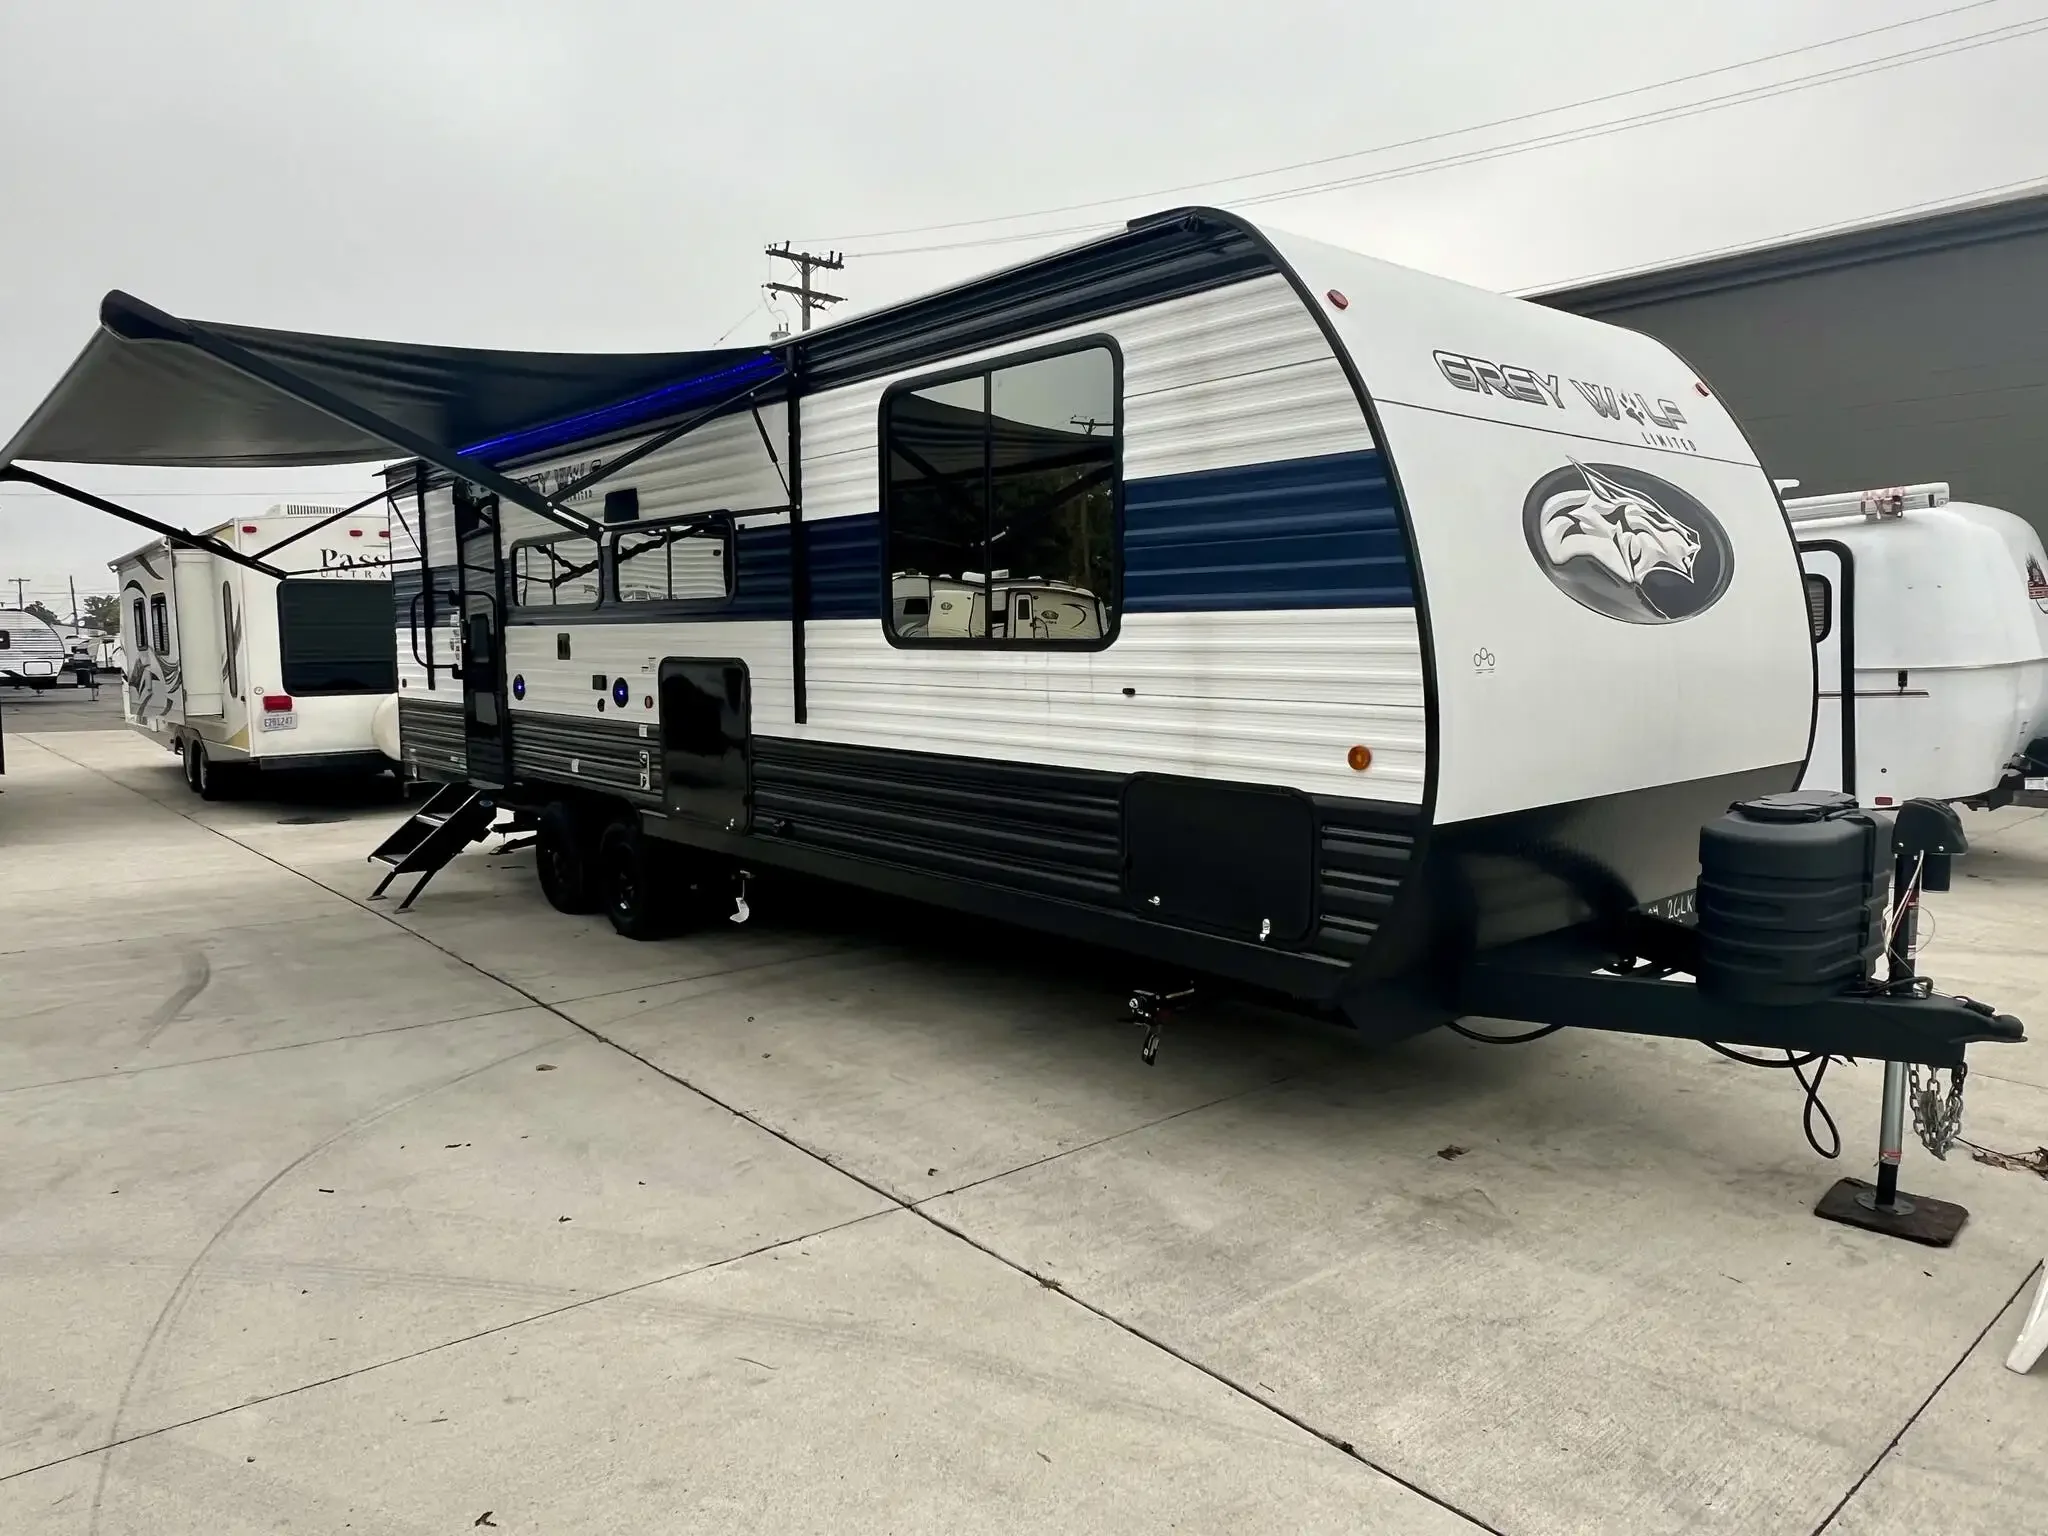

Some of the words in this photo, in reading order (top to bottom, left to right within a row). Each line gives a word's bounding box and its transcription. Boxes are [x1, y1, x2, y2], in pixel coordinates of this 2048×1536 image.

[1432, 349, 1565, 409] GREY
[1641, 432, 1696, 451] LIMITED
[321, 570, 386, 578] ULTRA
